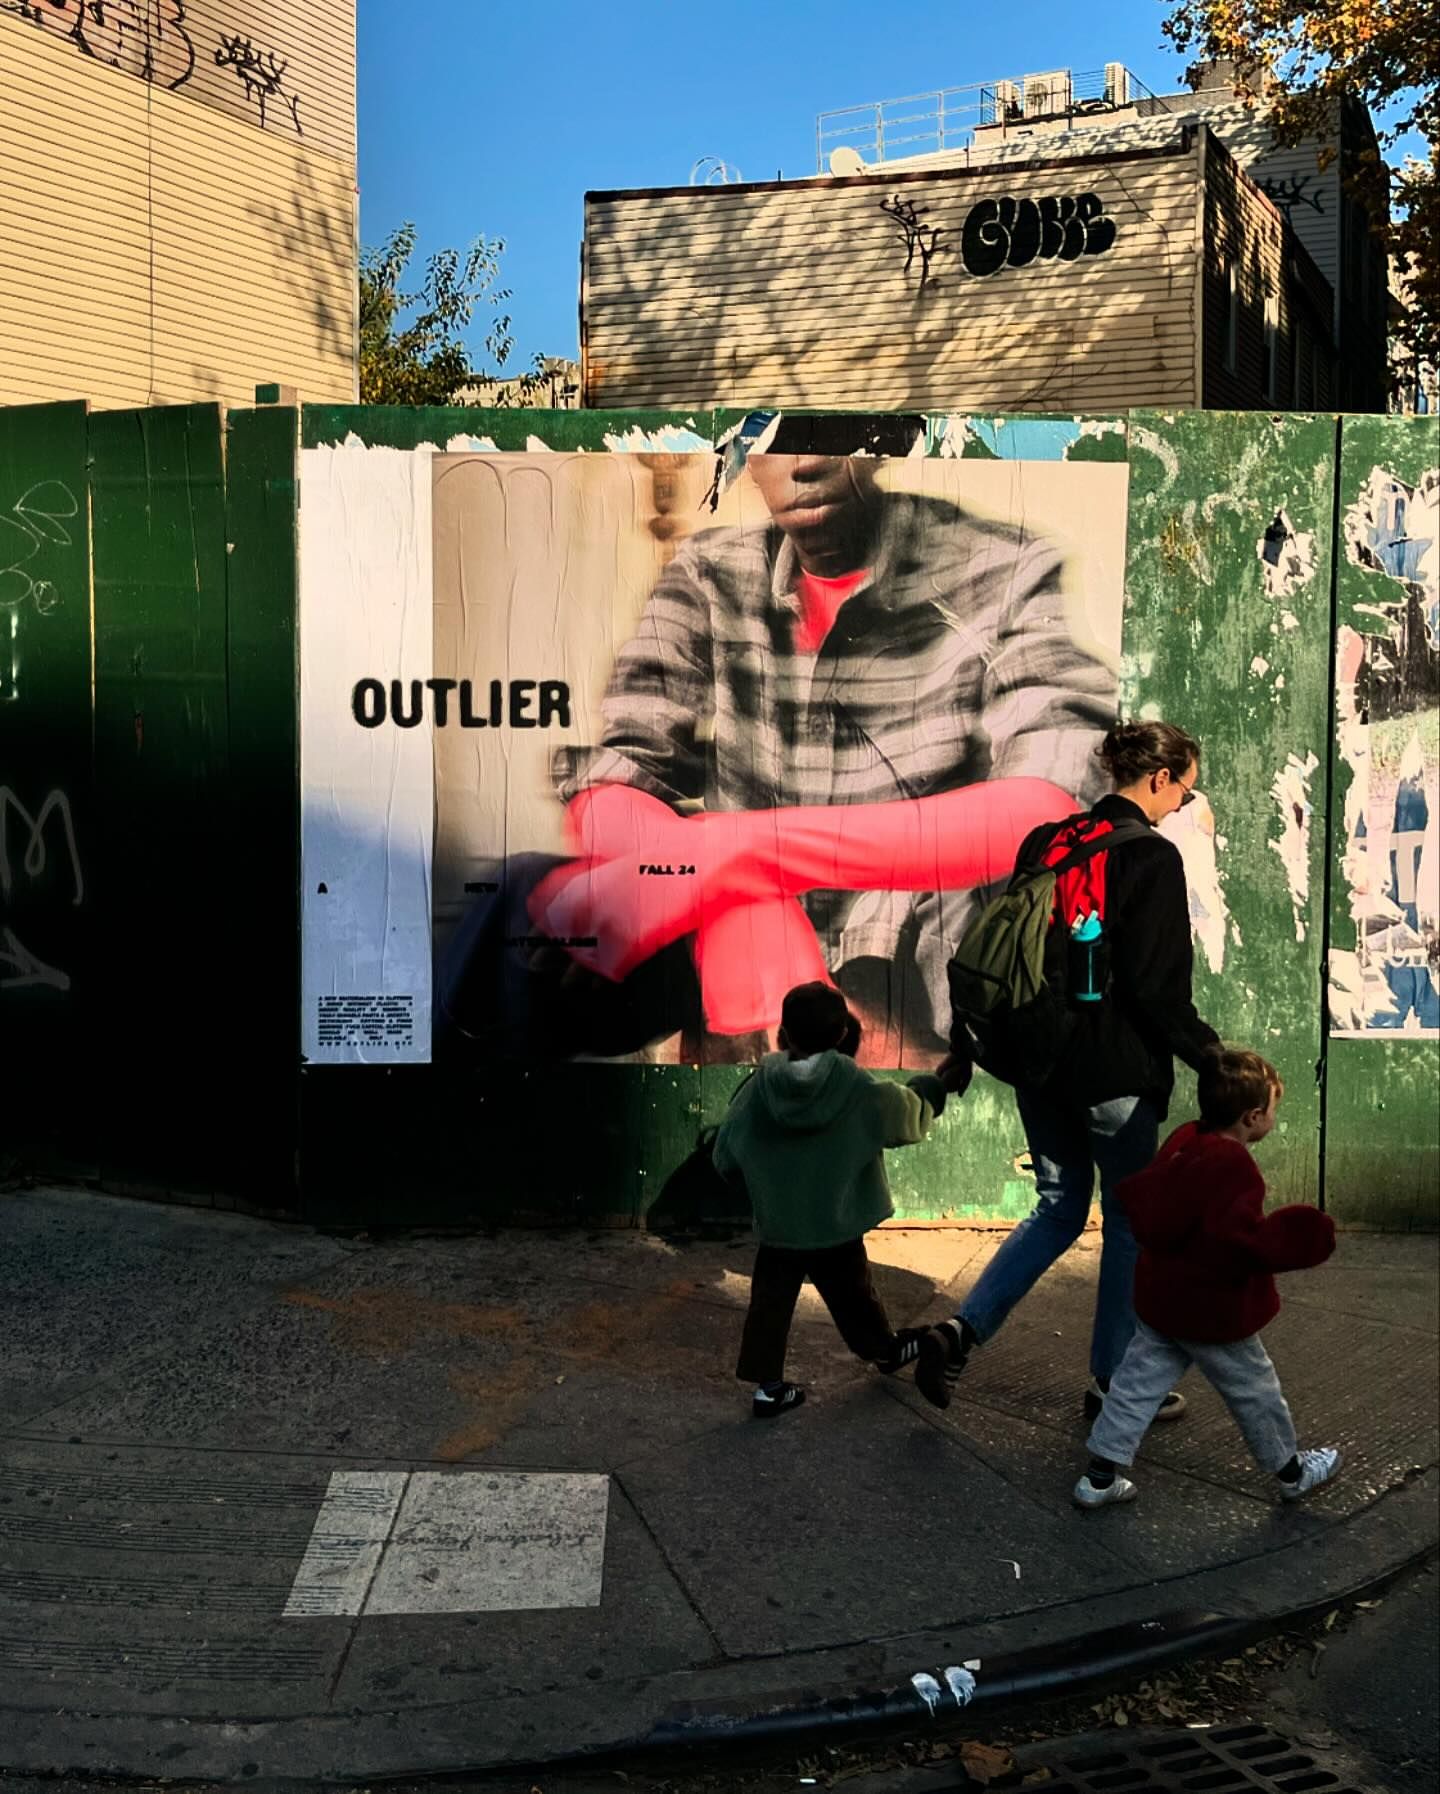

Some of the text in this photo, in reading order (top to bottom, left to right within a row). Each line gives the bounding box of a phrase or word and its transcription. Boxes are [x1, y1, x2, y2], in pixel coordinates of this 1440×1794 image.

[351, 677, 571, 728] OUTLIER
[639, 864, 696, 875] FALL 24
[317, 881, 329, 895] A
